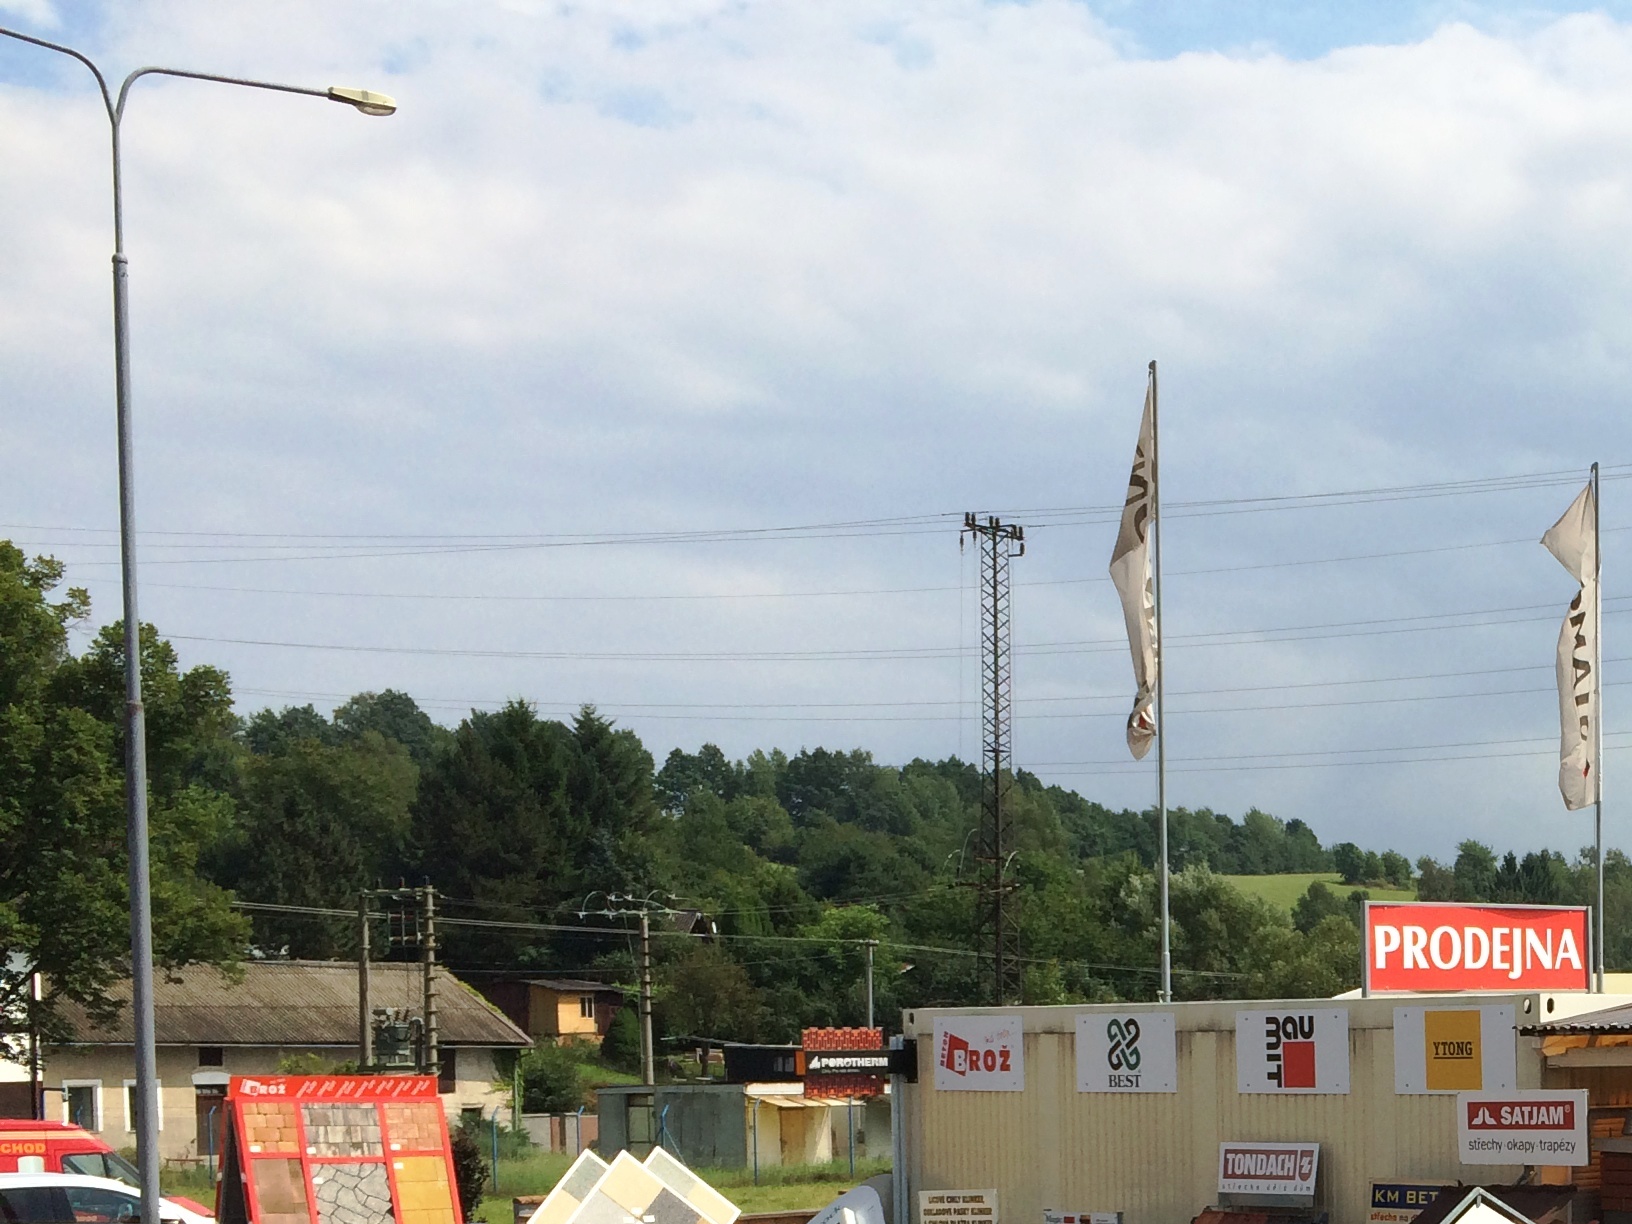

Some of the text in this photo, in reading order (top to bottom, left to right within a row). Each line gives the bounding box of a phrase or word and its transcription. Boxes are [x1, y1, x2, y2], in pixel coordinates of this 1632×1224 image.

[1374, 925, 1583, 980] PRODEJNA
[1433, 1041, 1473, 1056] YTONG
[821, 1057, 888, 1068] POROTHERM
[954, 1044, 1011, 1073] BROŽ
[1108, 1074, 1141, 1088] BEST
[1500, 1106, 1564, 1125] SATJAM
[1469, 1137, 1576, 1154] střechy okapy trapézy
[1226, 1153, 1295, 1177] TONDACH
[1375, 1189, 1399, 1204] KM
